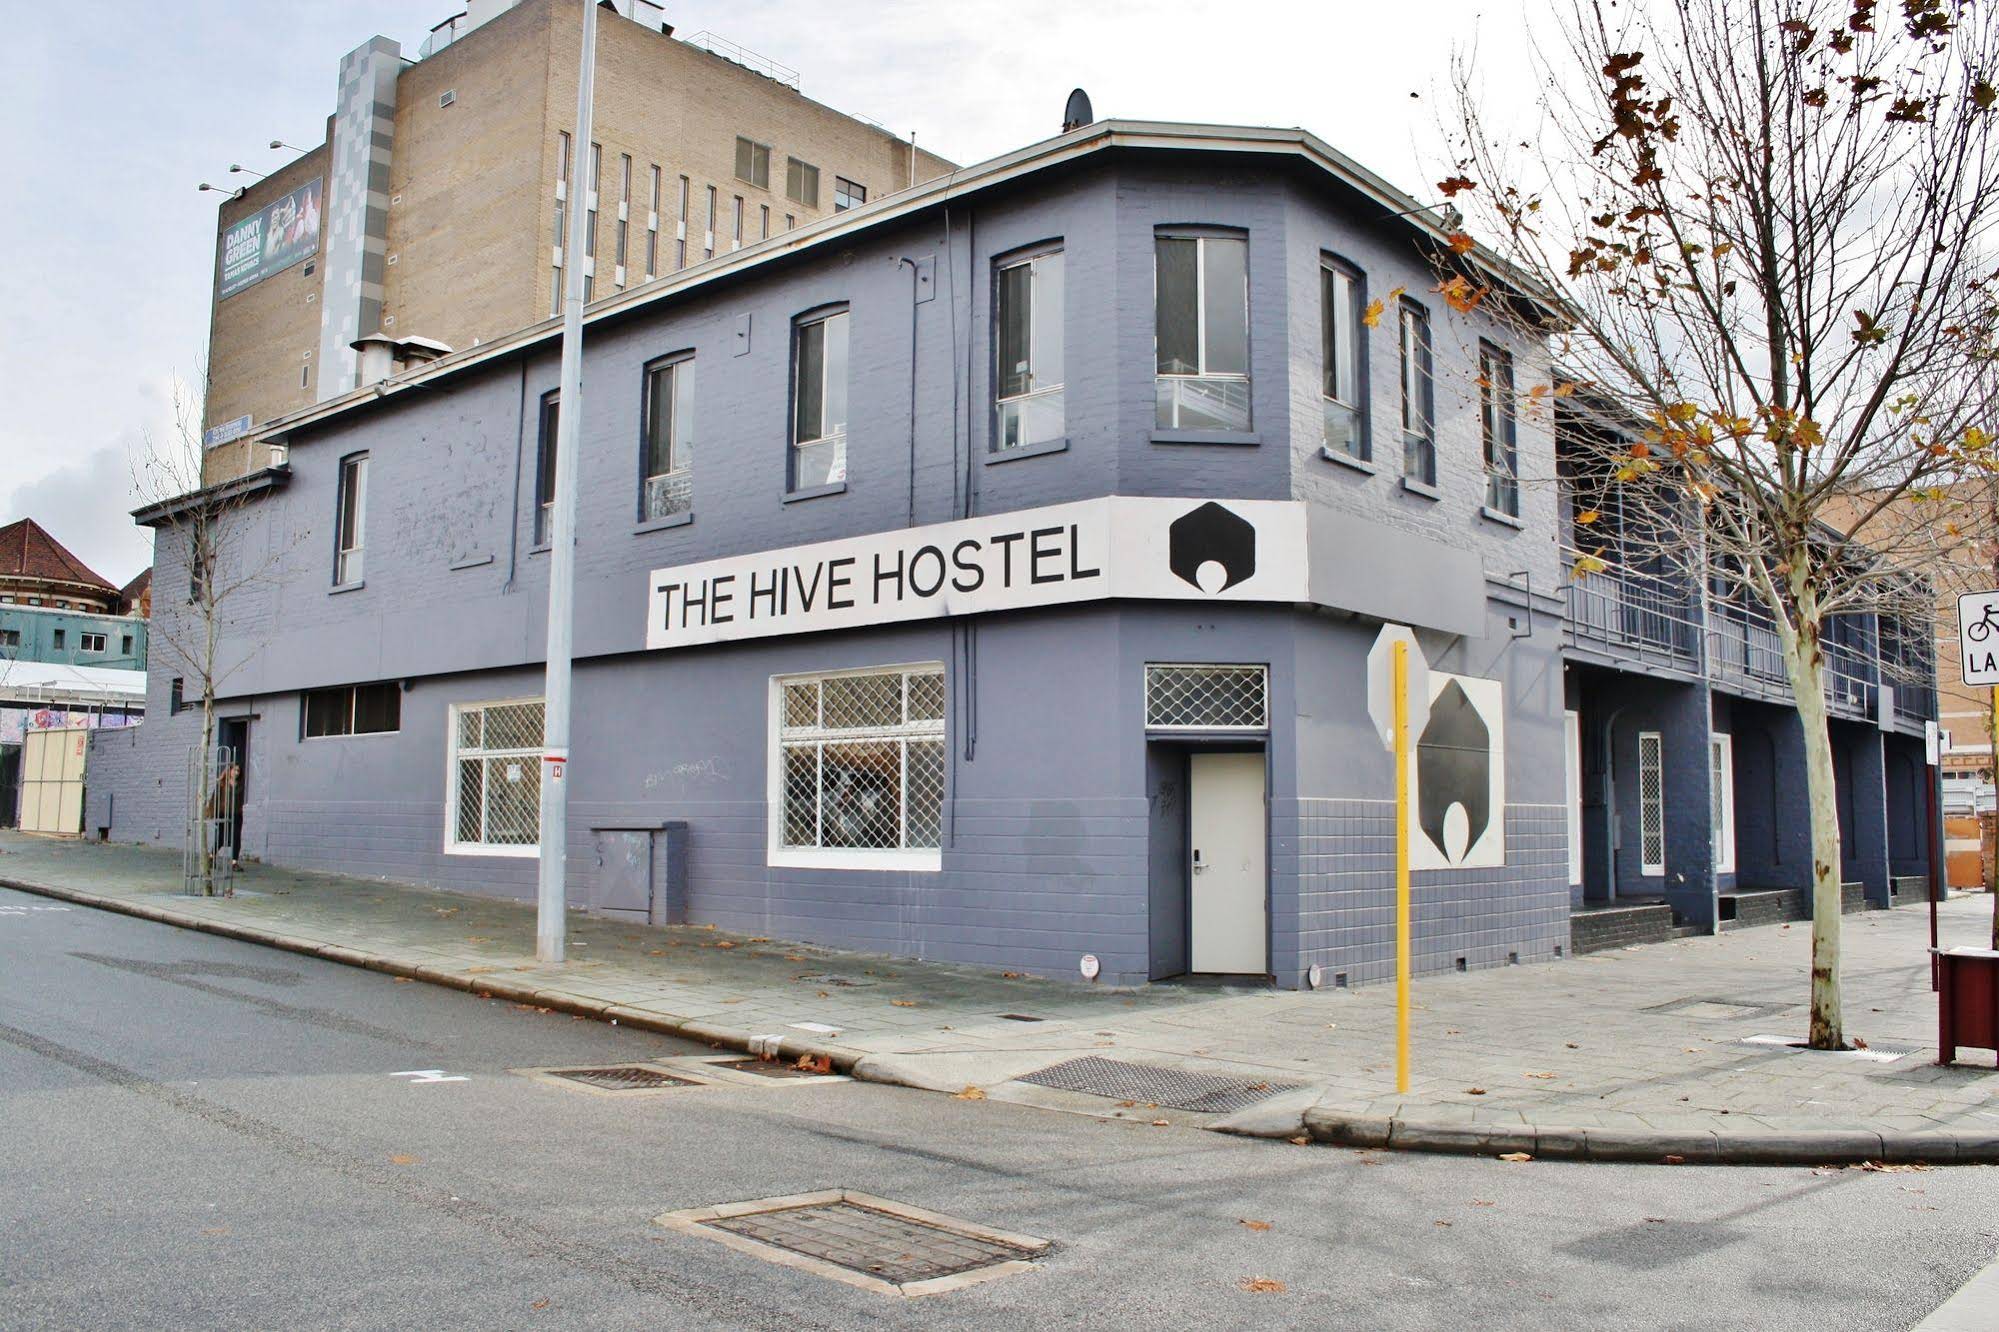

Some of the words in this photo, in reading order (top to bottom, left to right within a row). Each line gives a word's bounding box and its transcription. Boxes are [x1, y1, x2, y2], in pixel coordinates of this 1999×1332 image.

[226, 217, 262, 249] DANNY
[225, 234, 261, 265] GREEN
[658, 575, 735, 630] THE
[750, 557, 856, 618] HIVE
[873, 524, 1100, 604] HOSTEL
